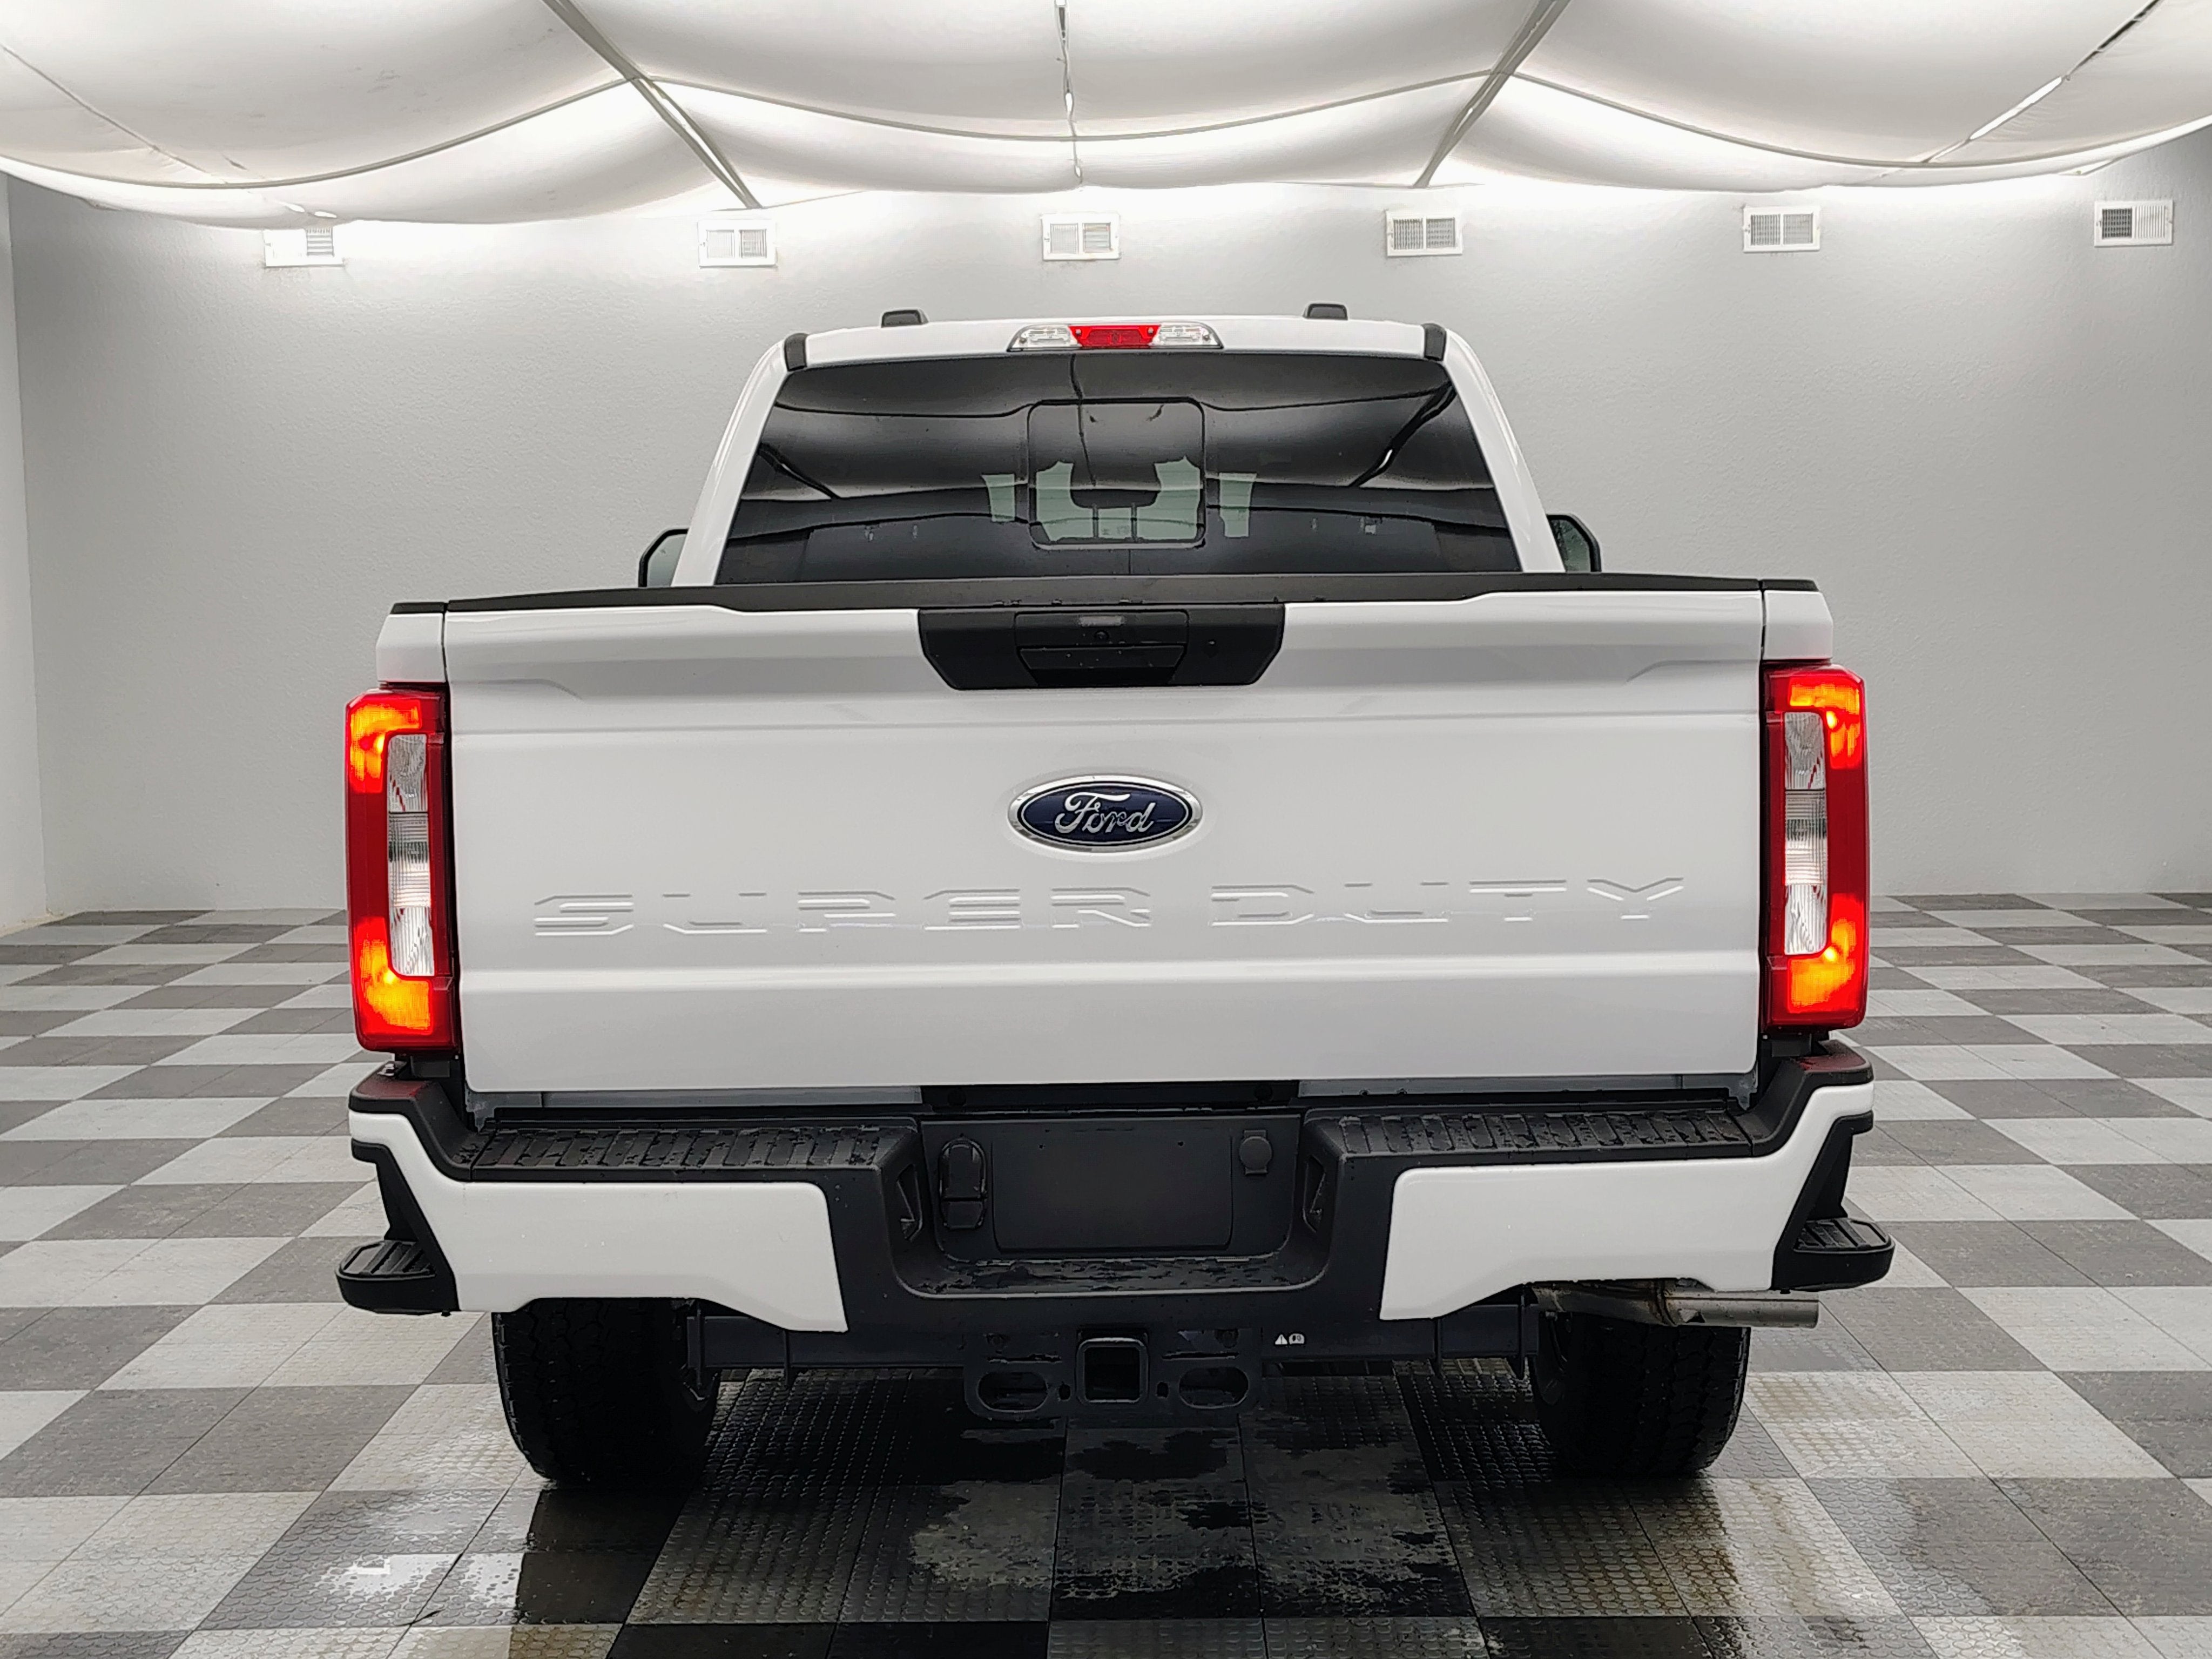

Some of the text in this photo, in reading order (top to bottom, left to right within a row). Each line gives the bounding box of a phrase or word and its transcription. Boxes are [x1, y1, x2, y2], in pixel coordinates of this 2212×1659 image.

[1054, 791, 1156, 834] Ford
[534, 876, 1684, 936] SUPER DUTY
